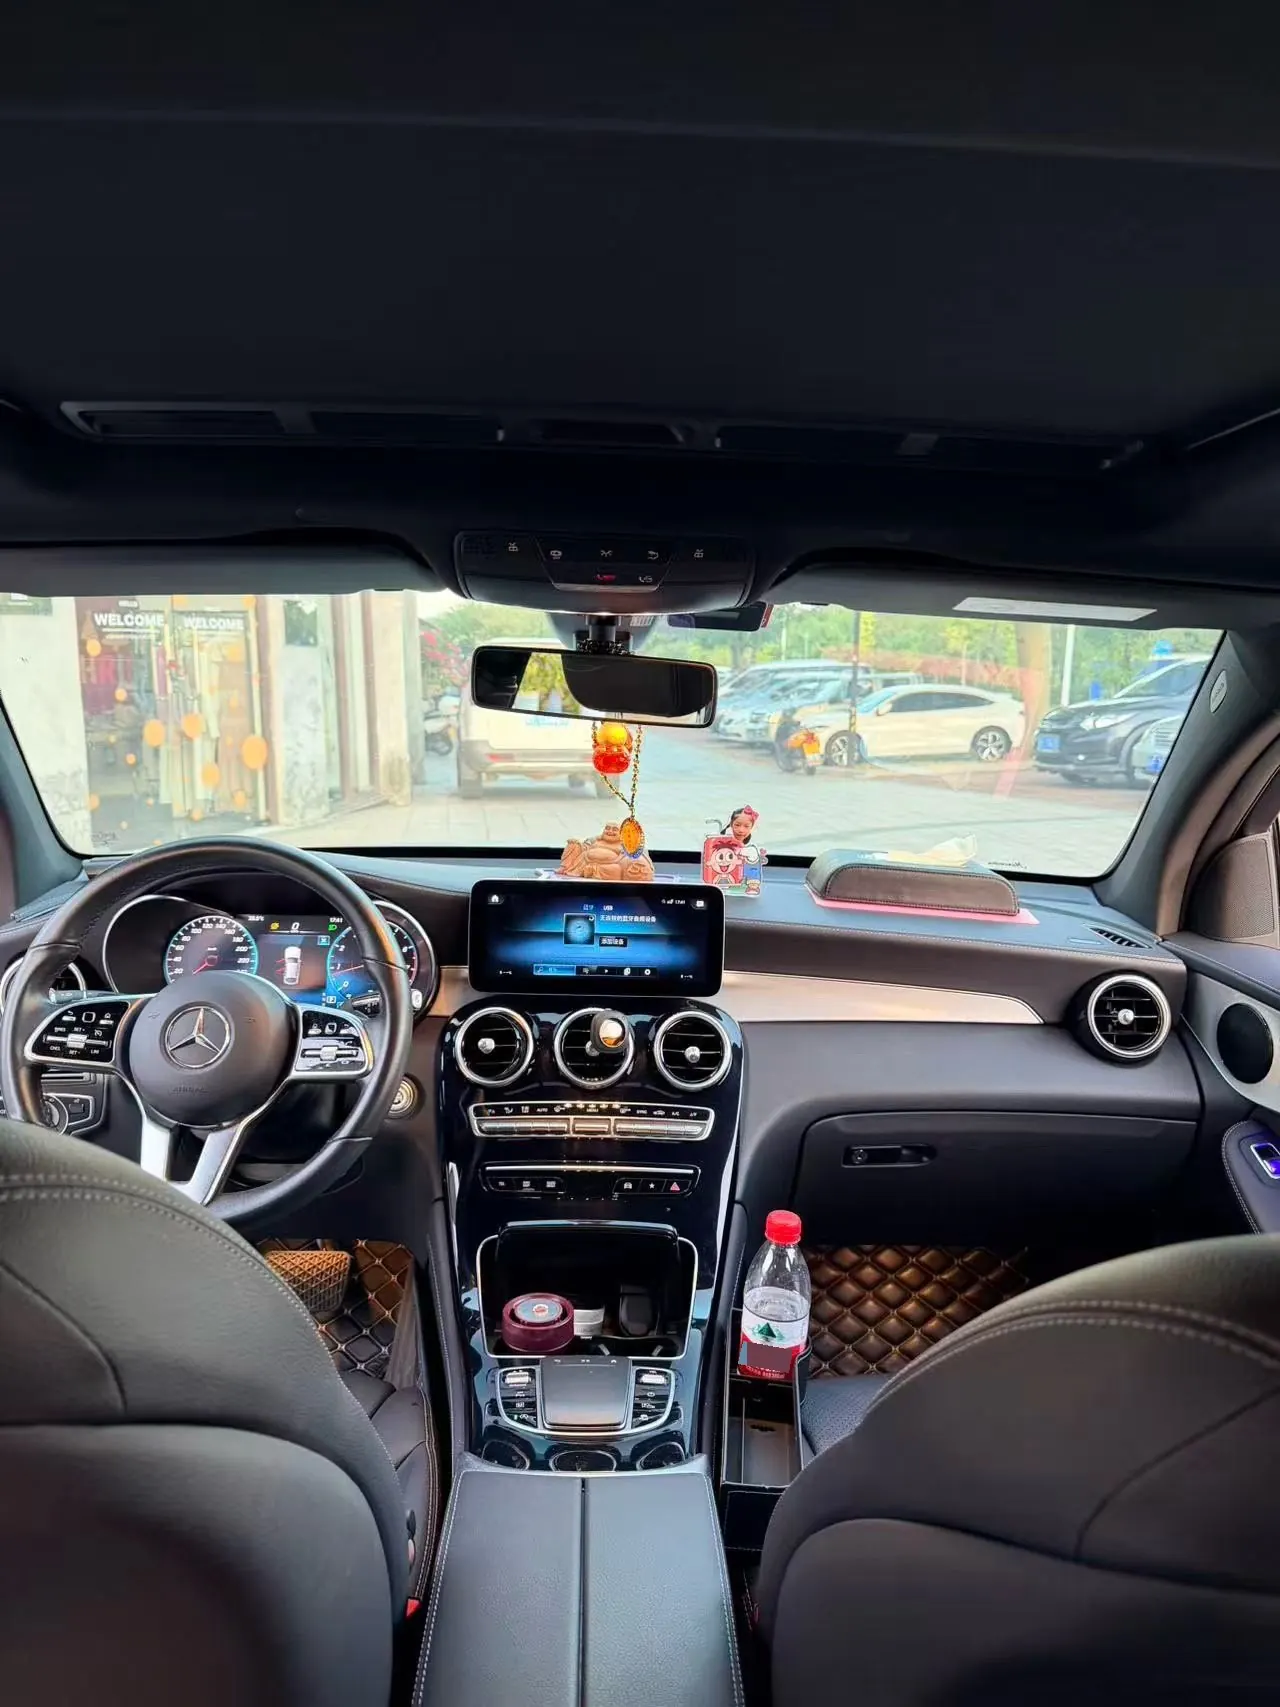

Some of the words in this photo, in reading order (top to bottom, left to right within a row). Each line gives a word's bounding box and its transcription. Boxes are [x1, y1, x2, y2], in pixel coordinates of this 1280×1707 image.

[94, 612, 165, 627] WELCOME
[184, 616, 244, 630] WELCOME
[291, 921, 300, 930] 0
[338, 944, 346, 952] 2
